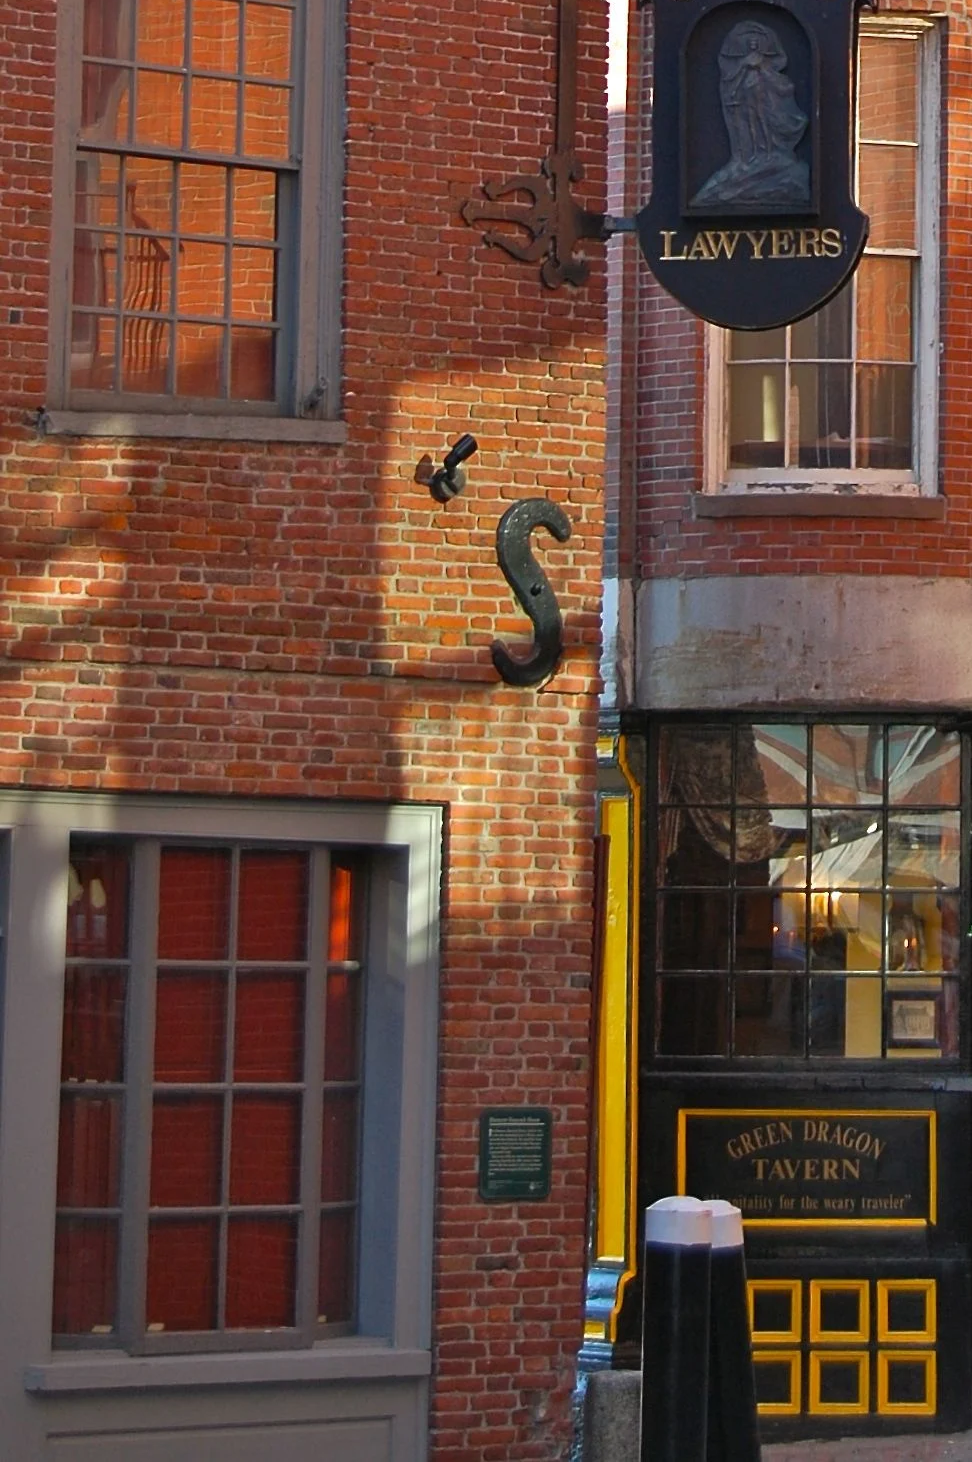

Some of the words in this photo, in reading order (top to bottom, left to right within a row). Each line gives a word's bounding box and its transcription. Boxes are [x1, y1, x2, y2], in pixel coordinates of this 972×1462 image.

[659, 228, 843, 261] LAWYERS
[726, 1120, 793, 1160] GREEN
[803, 1120, 887, 1160] DRAGON
[752, 1158, 861, 1180] TAVERN
[779, 1193, 796, 1210] for
[801, 1194, 819, 1210] the
[824, 1197, 856, 1213] weary
